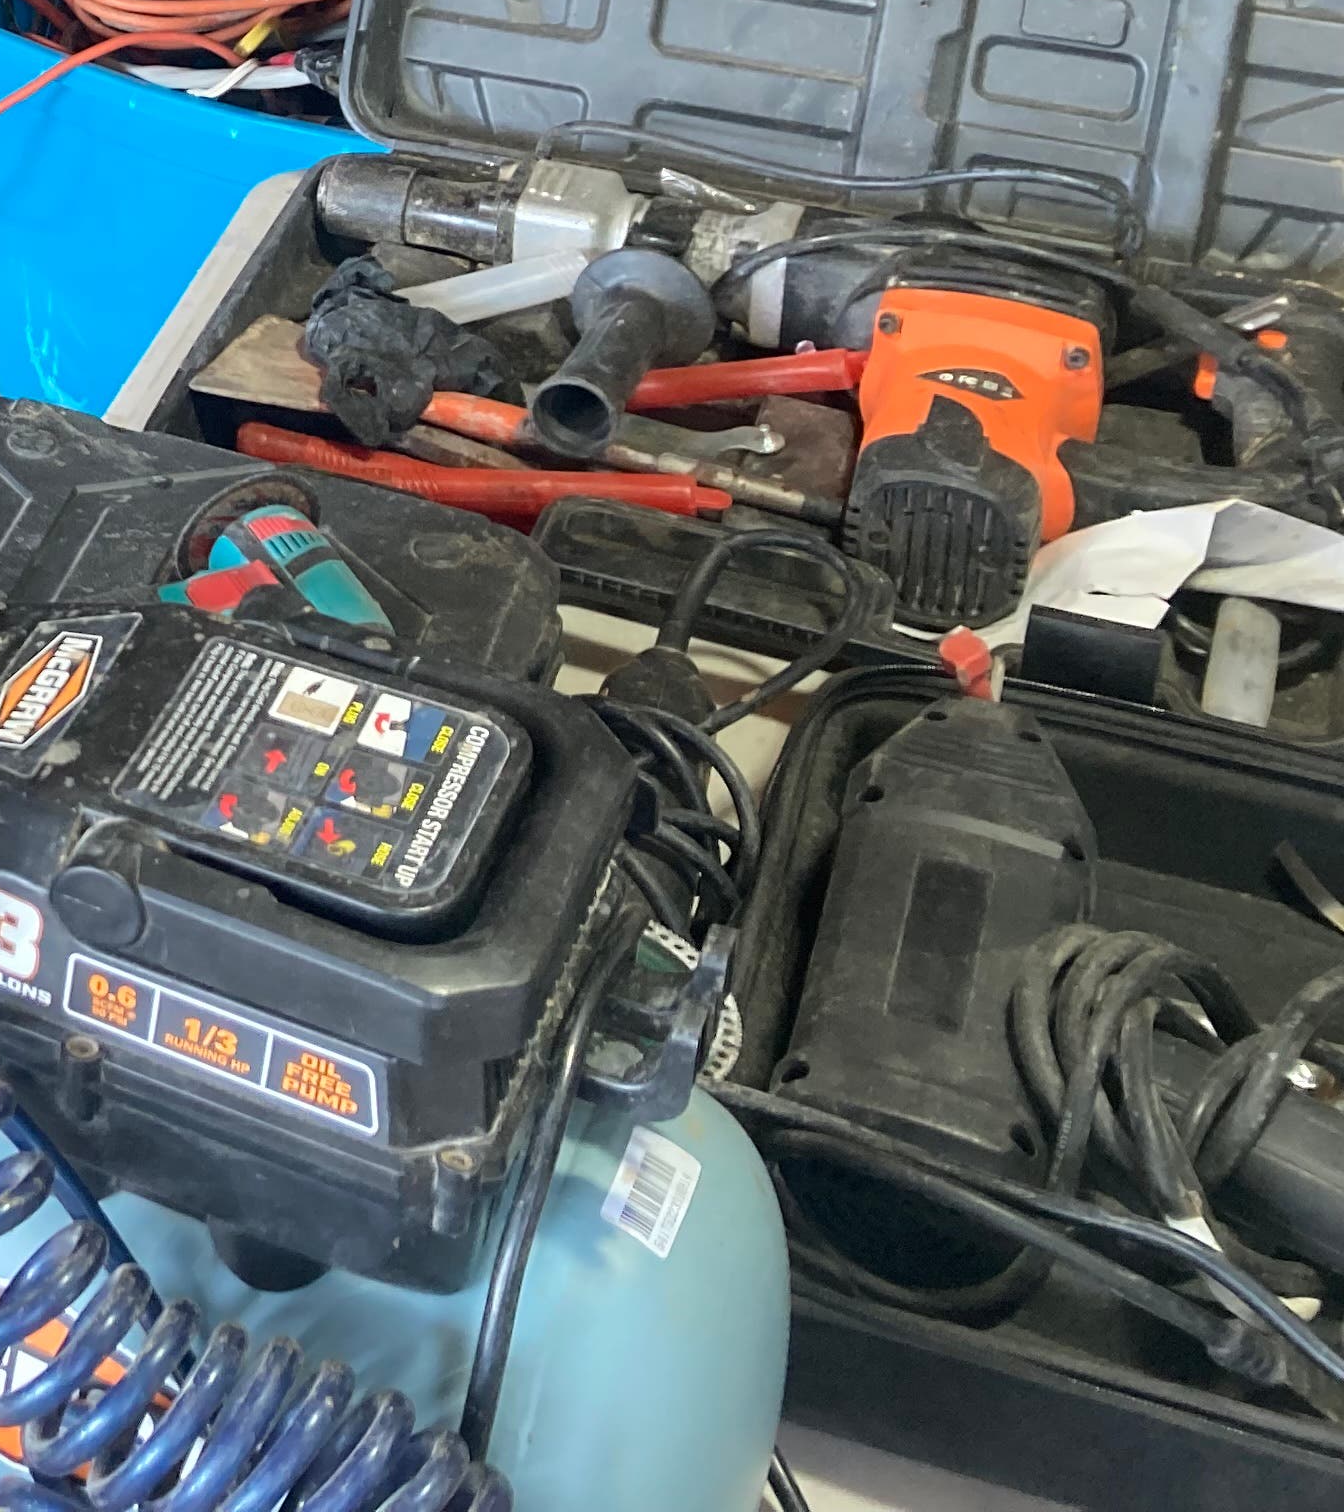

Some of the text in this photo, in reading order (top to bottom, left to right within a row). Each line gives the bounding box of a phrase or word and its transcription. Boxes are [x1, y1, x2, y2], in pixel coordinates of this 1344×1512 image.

[431, 725, 456, 756] CLOSE
[394, 725, 490, 888] COMPRESSOR START UP
[400, 782, 425, 812] CLOSE
[89, 974, 137, 1009] 0.6
[165, 1033, 251, 1074] RUNNING HP
[184, 1017, 238, 1055] 1/3
[286, 1062, 353, 1098] FREE
[301, 1051, 342, 1080] OIL
[282, 1076, 359, 1116] PUMP
